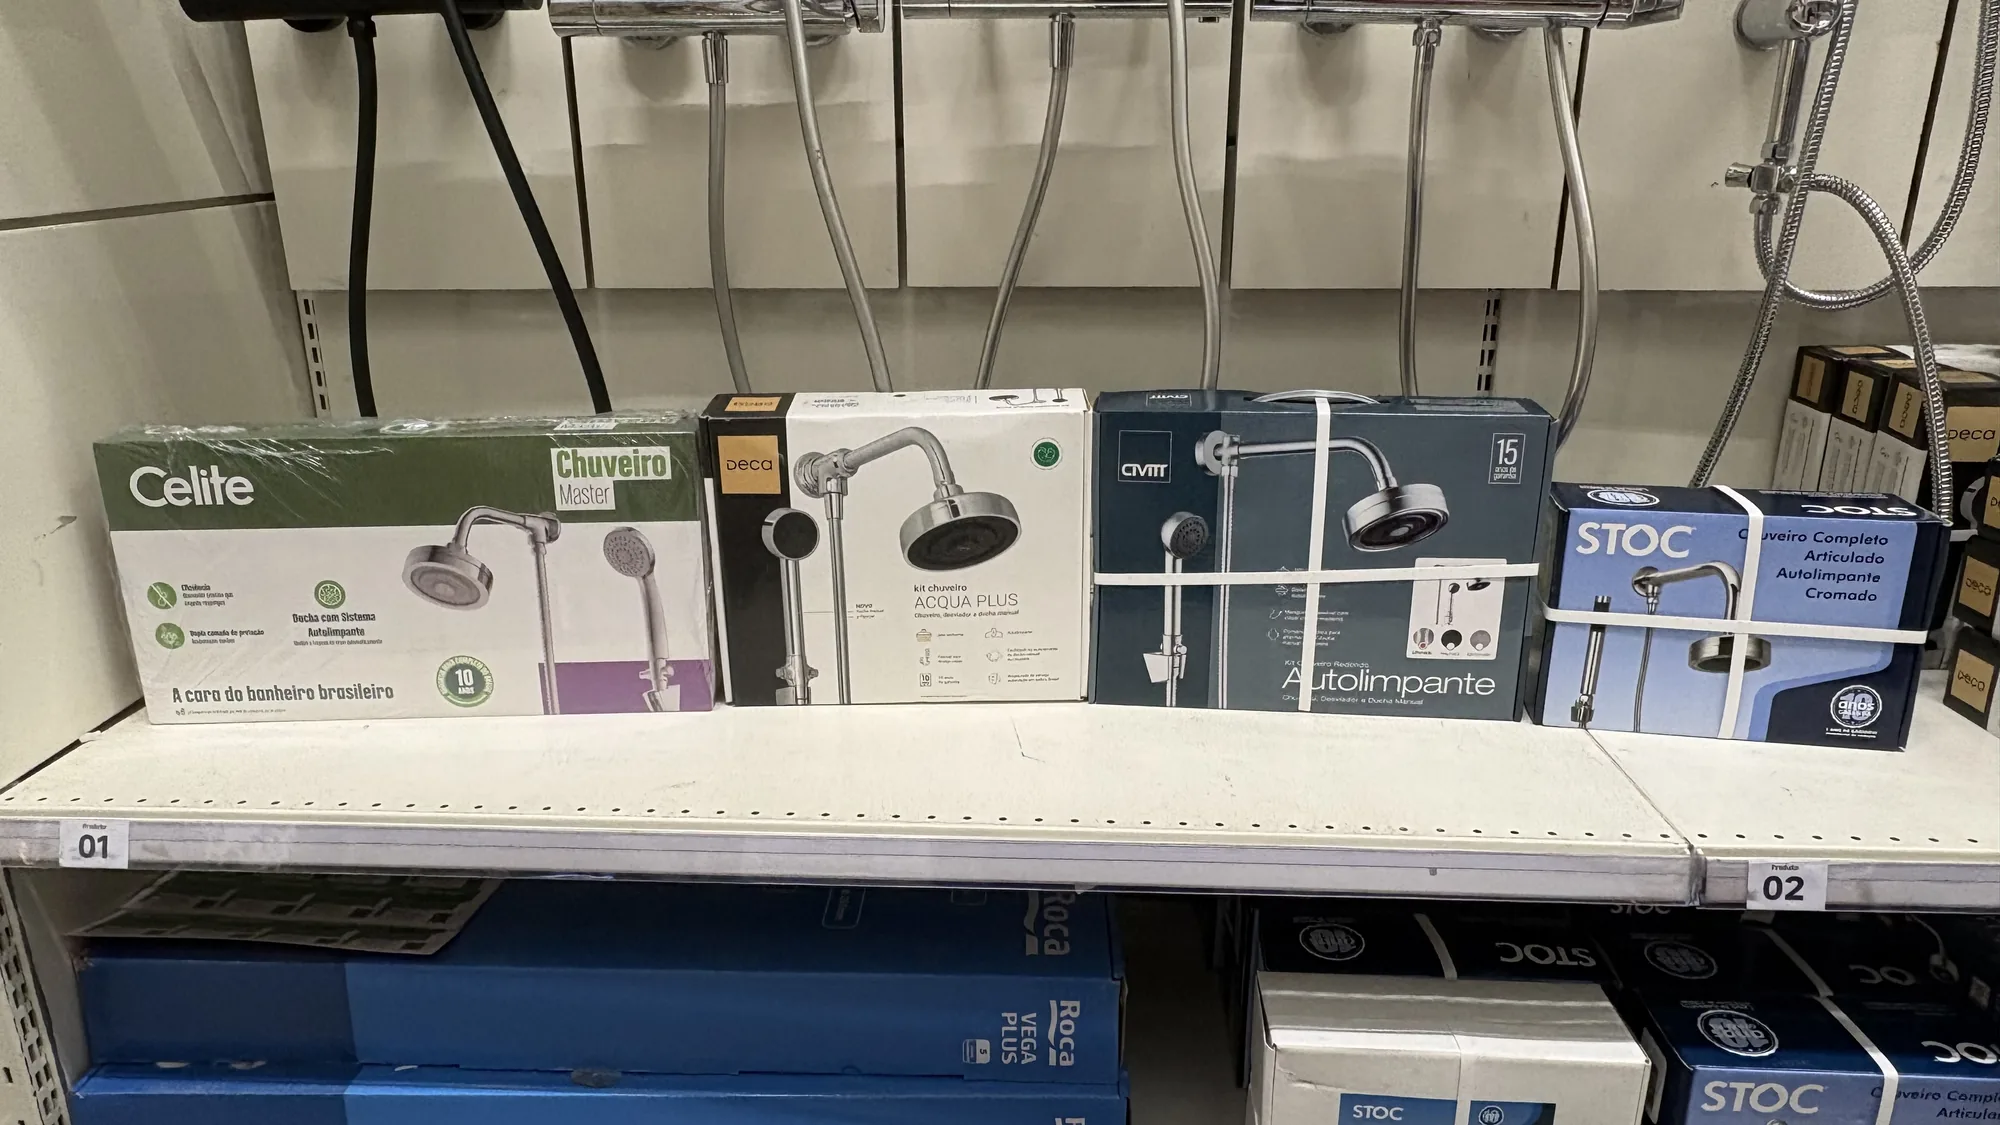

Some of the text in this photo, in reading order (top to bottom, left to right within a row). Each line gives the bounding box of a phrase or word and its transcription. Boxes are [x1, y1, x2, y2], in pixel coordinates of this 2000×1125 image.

[1497, 439, 1518, 465] 15
[556, 449, 667, 478] Chuveiro
[1121, 463, 1169, 477] CIVITT
[129, 465, 254, 507] Celite
[559, 484, 610, 505] Master
[1801, 505, 1917, 517] STOC
[1576, 522, 1696, 559] STOC
[1738, 529, 1889, 546] Cuveiro Completo
[1804, 550, 1885, 564] Articulado
[1776, 568, 1881, 583] Autolimpante
[914, 584, 967, 592] kit chuveiro
[1805, 588, 1877, 602] Cromado
[914, 593, 1018, 610] ACQUA PLUS
[292, 612, 376, 623] Ducha com Sistema
[308, 627, 365, 639] Autolimpante
[1334, 660, 1369, 668] Redondo
[455, 669, 474, 686] 10
[1282, 667, 1495, 698] Autolimpante
[172, 683, 394, 703] A cara do banheiro brasileiro
[1838, 701, 1875, 711] anos
[79, 834, 108, 859] 01
[1763, 875, 1804, 901] 02
[1044, 891, 1075, 955] Roca
[1495, 942, 1597, 967] STOC
[1001, 1012, 1017, 1065] PLUS
[1021, 1013, 1037, 1065] VEGA
[1059, 1000, 1080, 1066] Roca
[1701, 1081, 1826, 1114] STOC
[1870, 1086, 1941, 1101] Cuveiro
[1353, 1105, 1404, 1121] STOC
